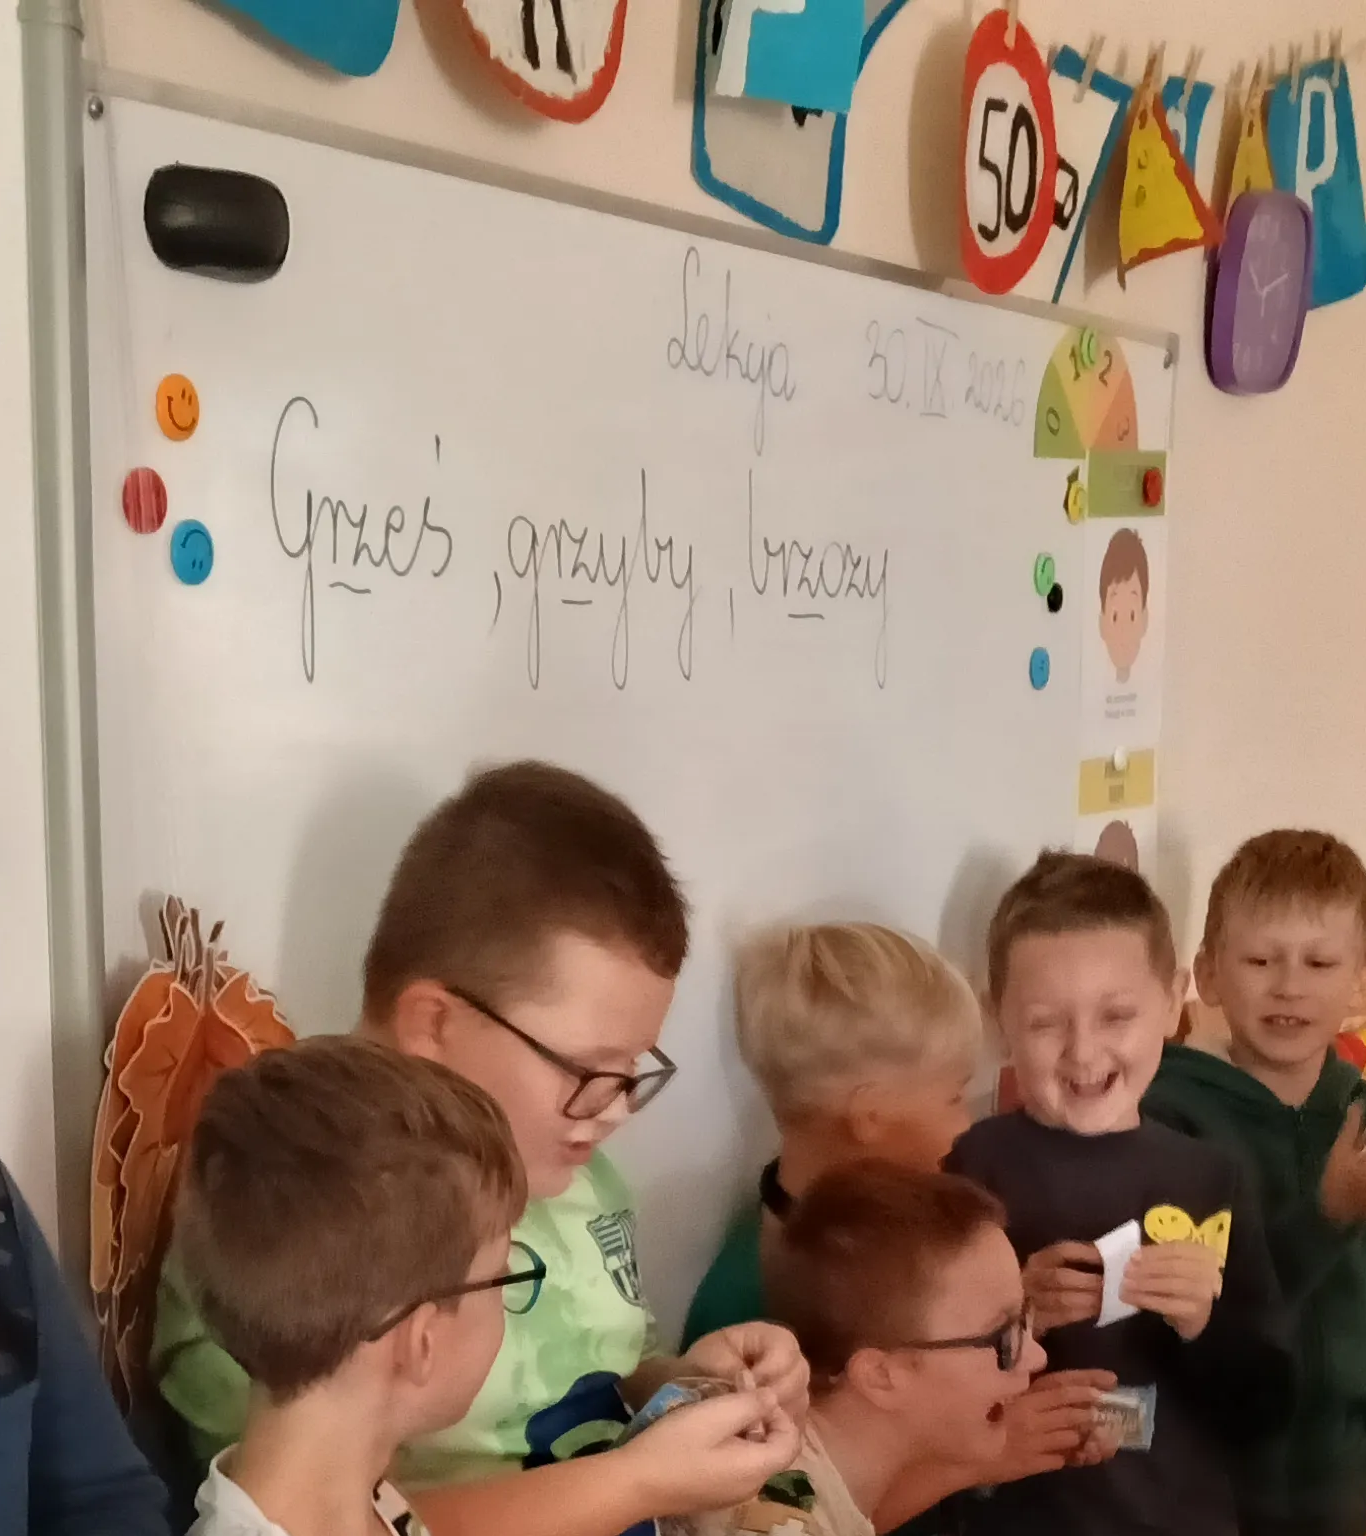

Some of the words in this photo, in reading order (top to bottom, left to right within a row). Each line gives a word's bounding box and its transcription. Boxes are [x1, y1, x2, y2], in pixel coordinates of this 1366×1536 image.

[978, 98, 1037, 242] 50
[1296, 76, 1339, 212] P
[667, 246, 796, 457] Lekcja
[271, 396, 453, 684] Grześ
